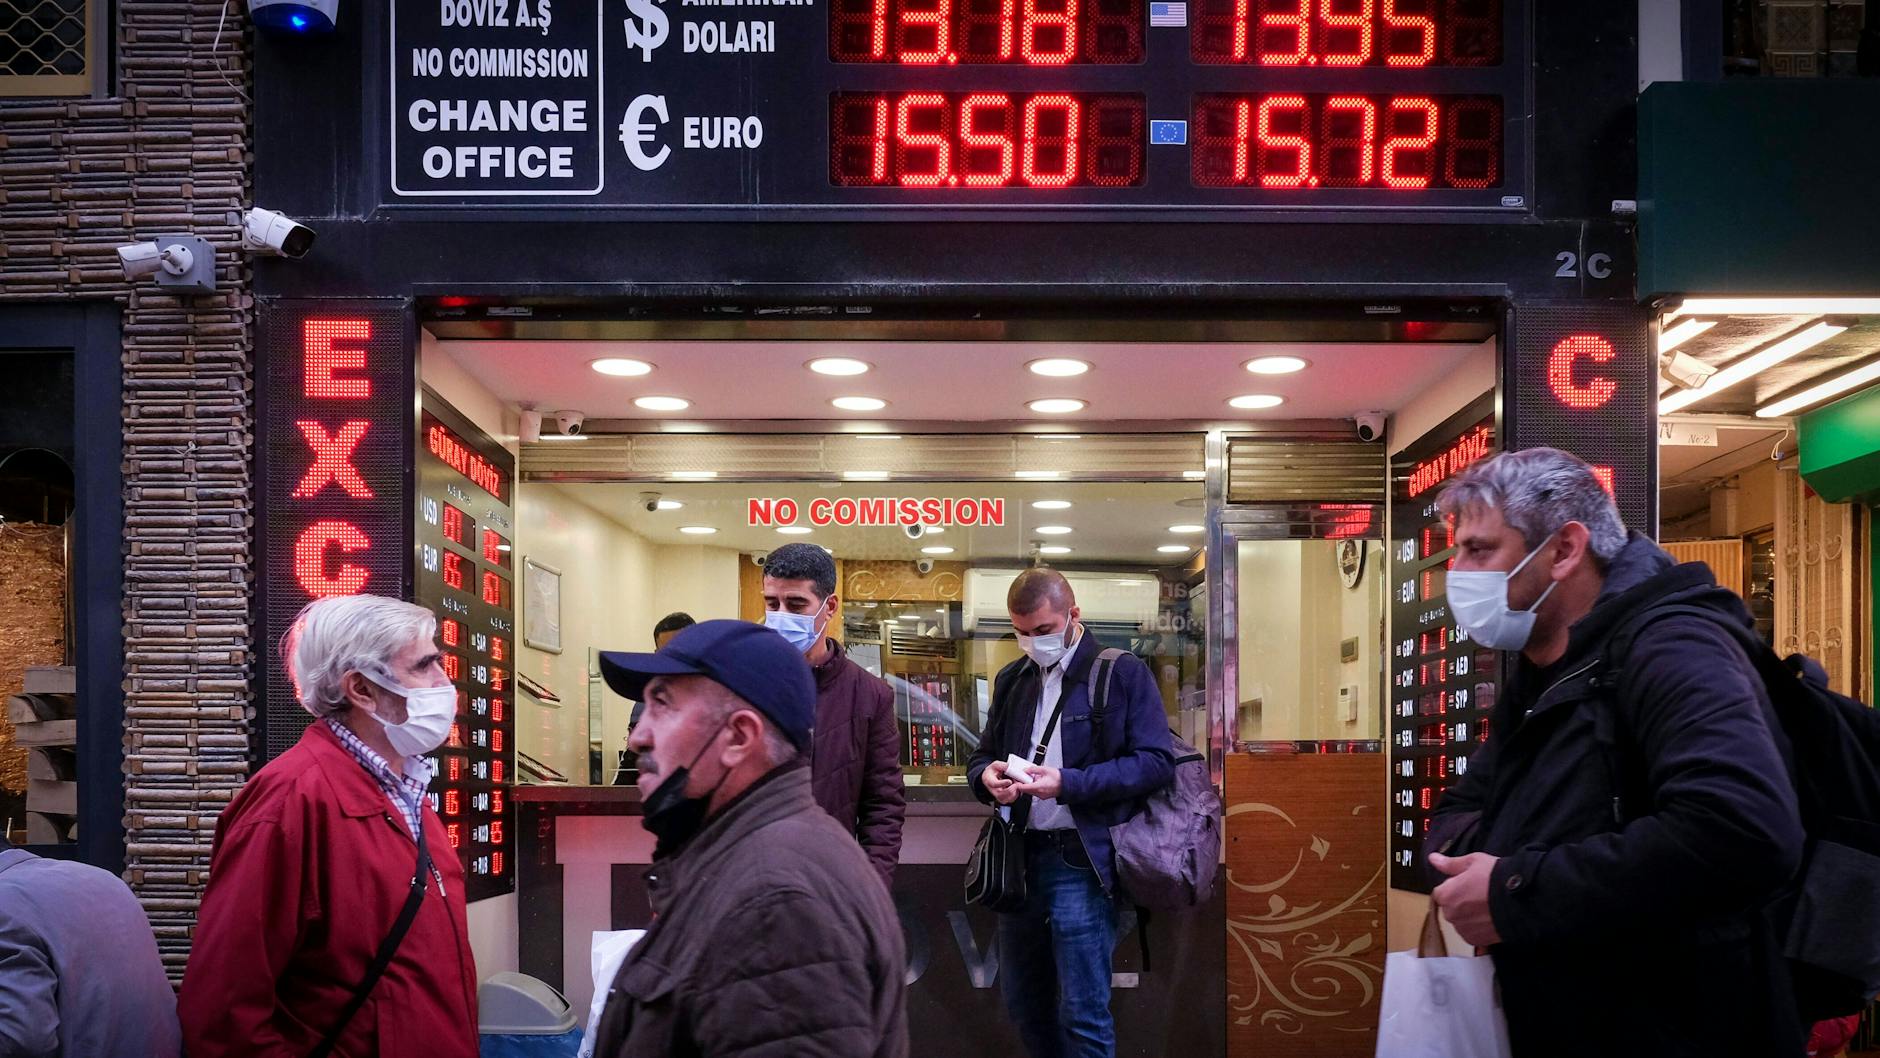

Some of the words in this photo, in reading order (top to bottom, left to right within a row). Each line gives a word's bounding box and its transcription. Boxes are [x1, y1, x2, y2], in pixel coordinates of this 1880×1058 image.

[683, 20, 775, 53] DOLARI
[1233, 0, 1436, 67] 13.95
[412, 48, 443, 77] NO
[449, 48, 588, 77] COMMISSION
[408, 99, 588, 132] CHANGE
[683, 115, 763, 149] EURO
[871, 94, 1080, 186] 15.50
[1233, 96, 1439, 188] 15.72
[422, 145, 574, 179] OFFICE
[430, 426, 469, 475] GÜRAY
[1408, 453, 1448, 498] GÜRAY
[423, 496, 438, 526] USD
[747, 498, 798, 526] NO
[808, 497, 1005, 527] COMISSION
[423, 543, 438, 573] EUR
[1402, 538, 1415, 563] USD
[1402, 579, 1415, 604] EUR
[1402, 638, 1414, 657] GBP
[1455, 655, 1469, 676] AED
[1455, 688, 1468, 709] SYP
[1402, 789, 1414, 807] CAD
[1402, 849, 1413, 867] JPY
